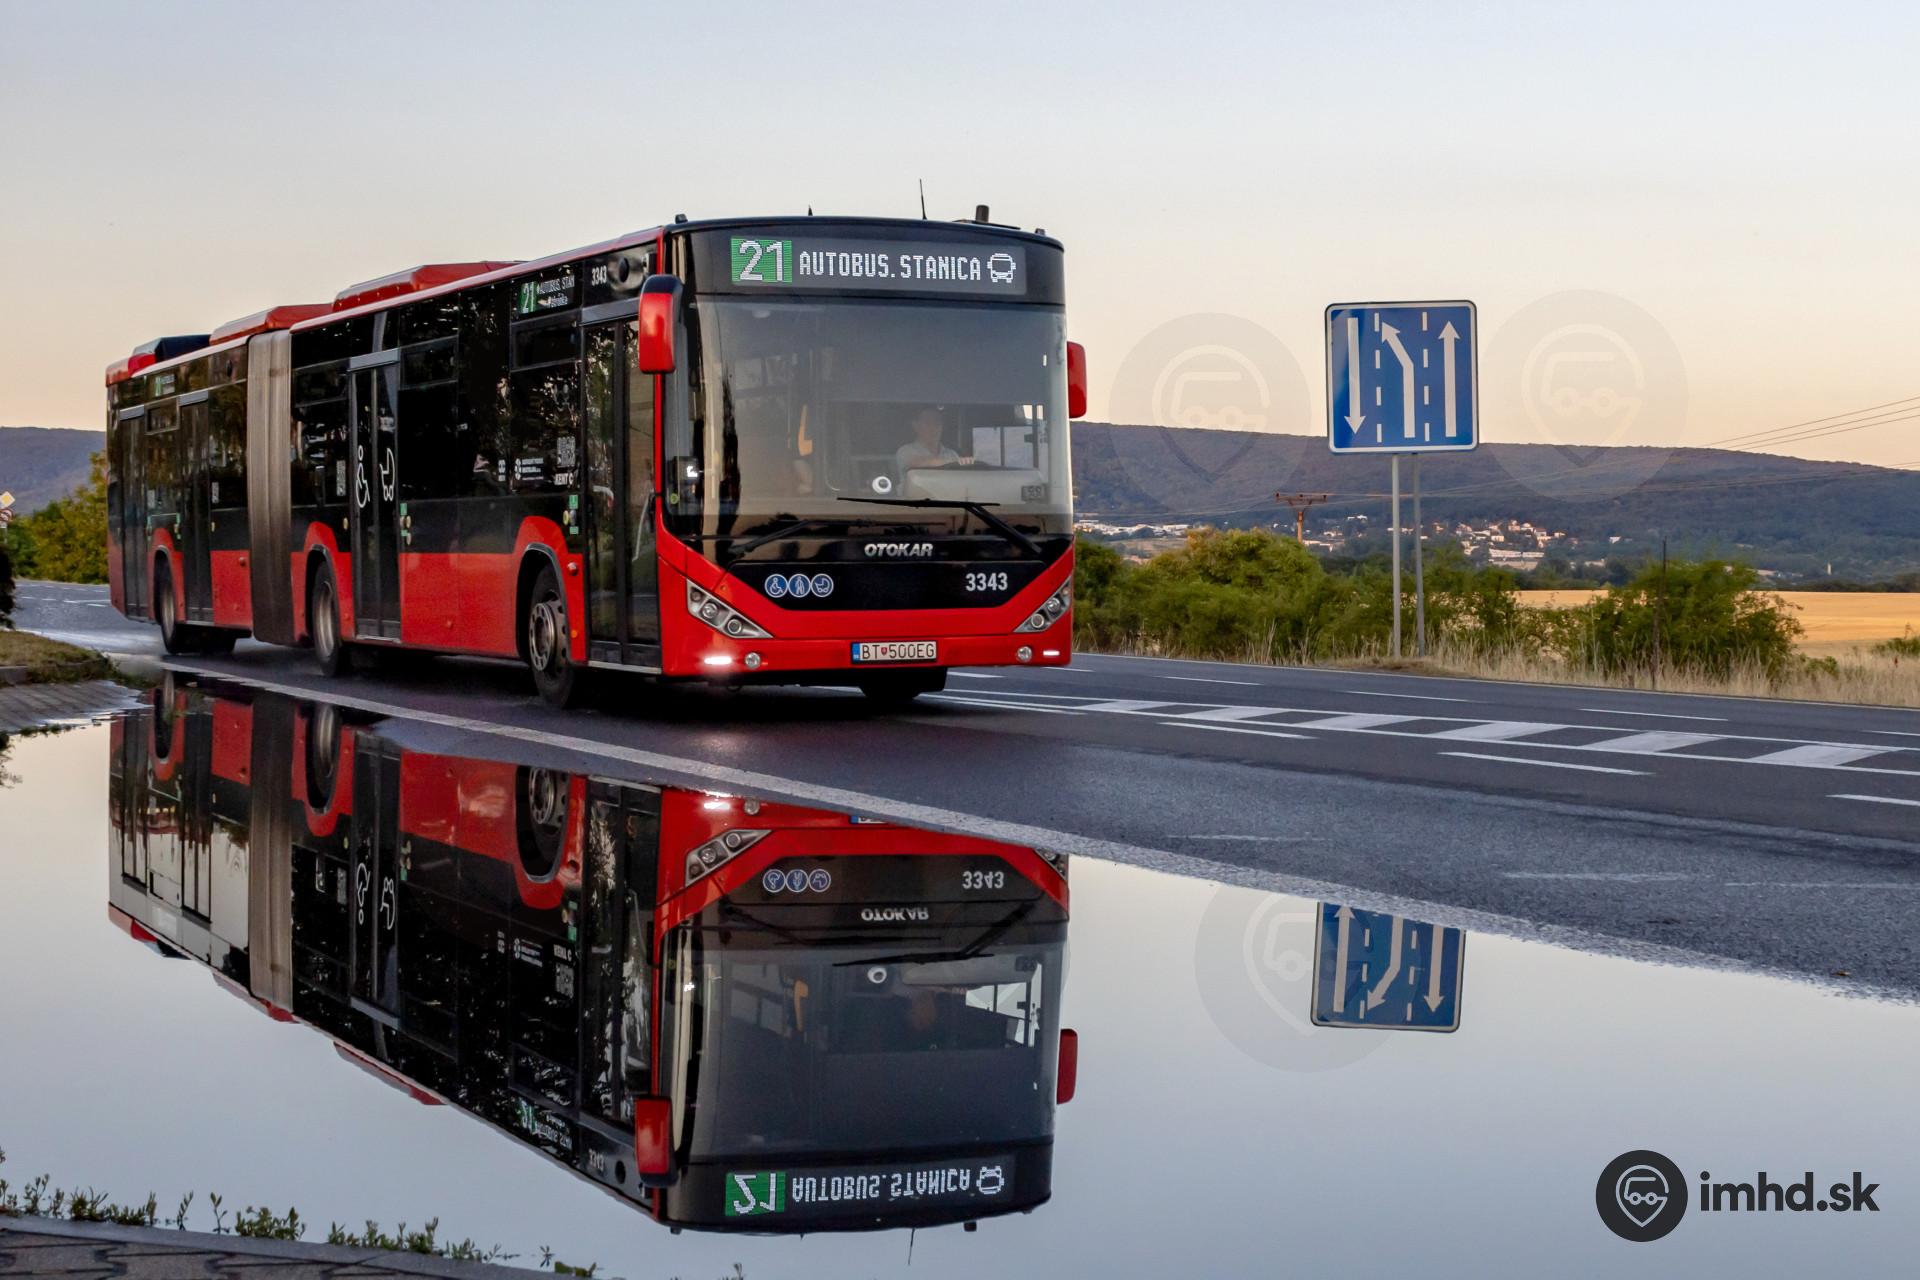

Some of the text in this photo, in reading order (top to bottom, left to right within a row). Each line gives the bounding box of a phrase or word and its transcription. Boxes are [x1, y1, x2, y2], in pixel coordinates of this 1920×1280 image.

[738, 240, 785, 283] 21
[591, 265, 607, 287] 3343
[522, 281, 535, 314] 21
[864, 542, 934, 558] OTOKAR
[965, 572, 1008, 592] 3343
